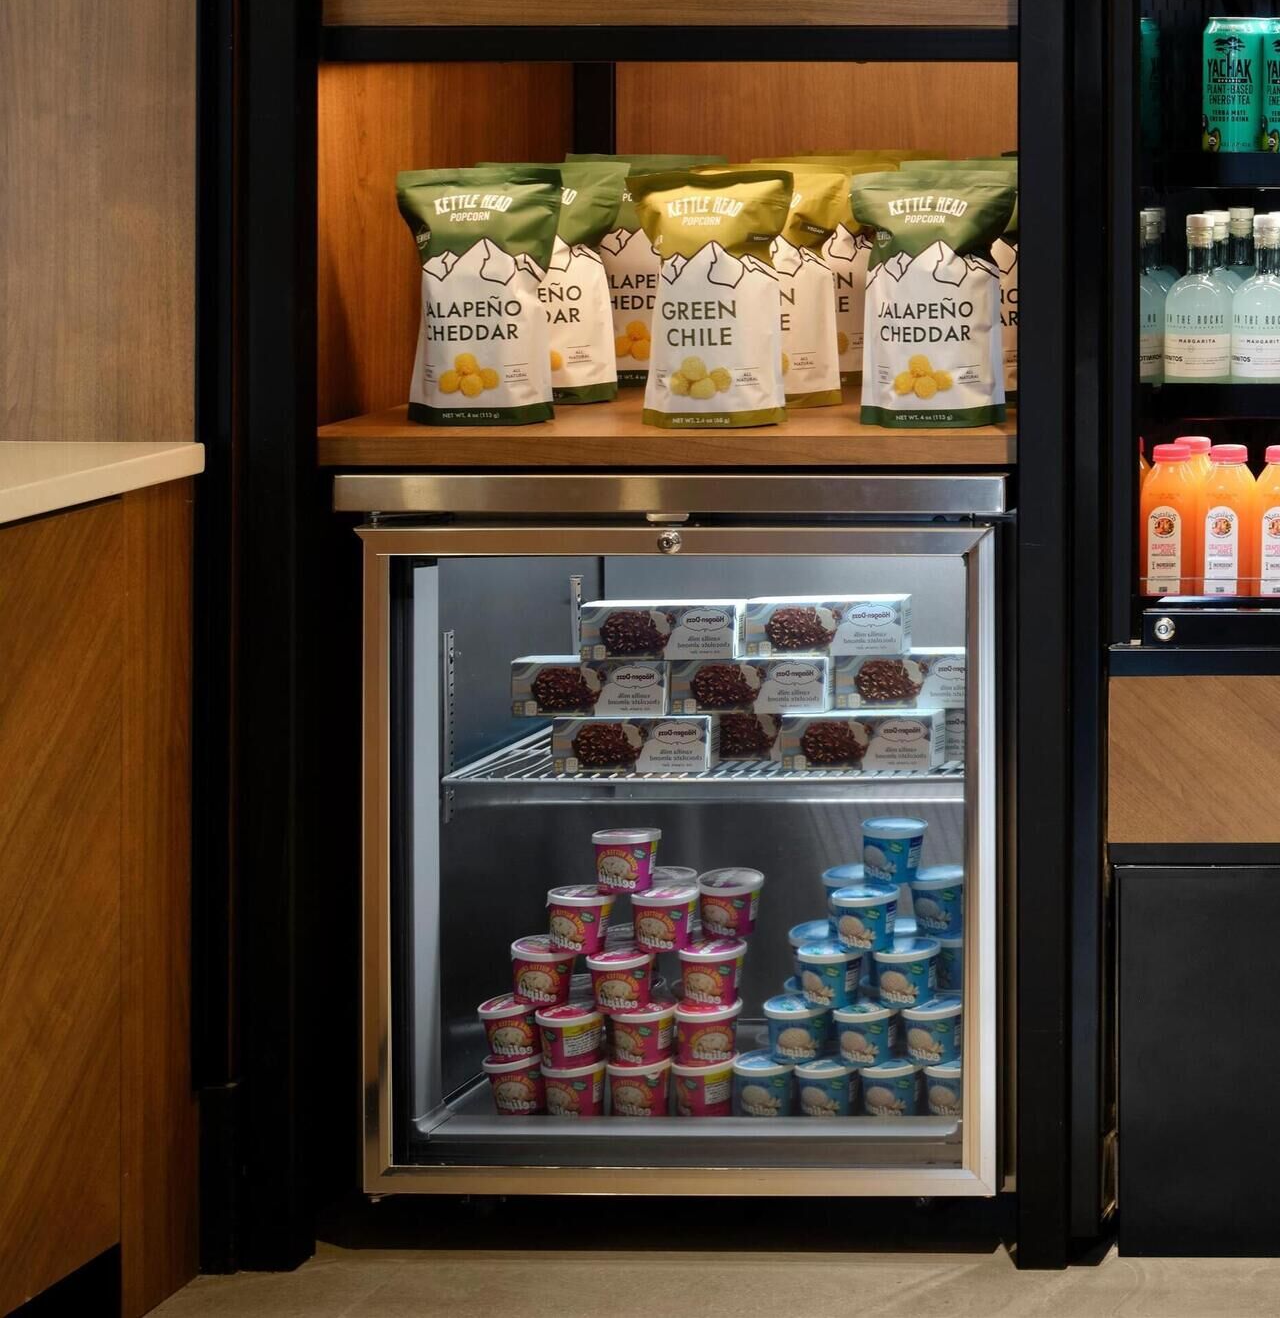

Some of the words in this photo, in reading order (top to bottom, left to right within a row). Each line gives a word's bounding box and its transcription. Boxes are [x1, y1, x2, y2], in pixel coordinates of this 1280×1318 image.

[1208, 56, 1251, 82] YACHAK
[1207, 84, 1252, 95] PLANT-BASED
[1209, 95, 1235, 105] ENERGY
[1237, 97, 1250, 105] TEA
[433, 195, 480, 214] KETTLE
[483, 195, 513, 211] HEAD
[666, 197, 712, 218] KETTLE
[714, 197, 744, 217] HEAD
[889, 196, 933, 216] KETTLE
[936, 197, 968, 217] HEAD
[450, 211, 490, 222] POPCORN
[681, 216, 721, 226] POPCORN
[904, 215, 946, 224] POPCORN
[426, 296, 521, 318] ALAPEÑO
[662, 300, 737, 320] GREEN
[878, 298, 974, 319] JALAPEÑO
[1176, 313, 1192, 325] THE
[1197, 314, 1224, 326] ROCKS
[667, 327, 732, 347] CHILE
[880, 325, 971, 342] CHEDDAR
